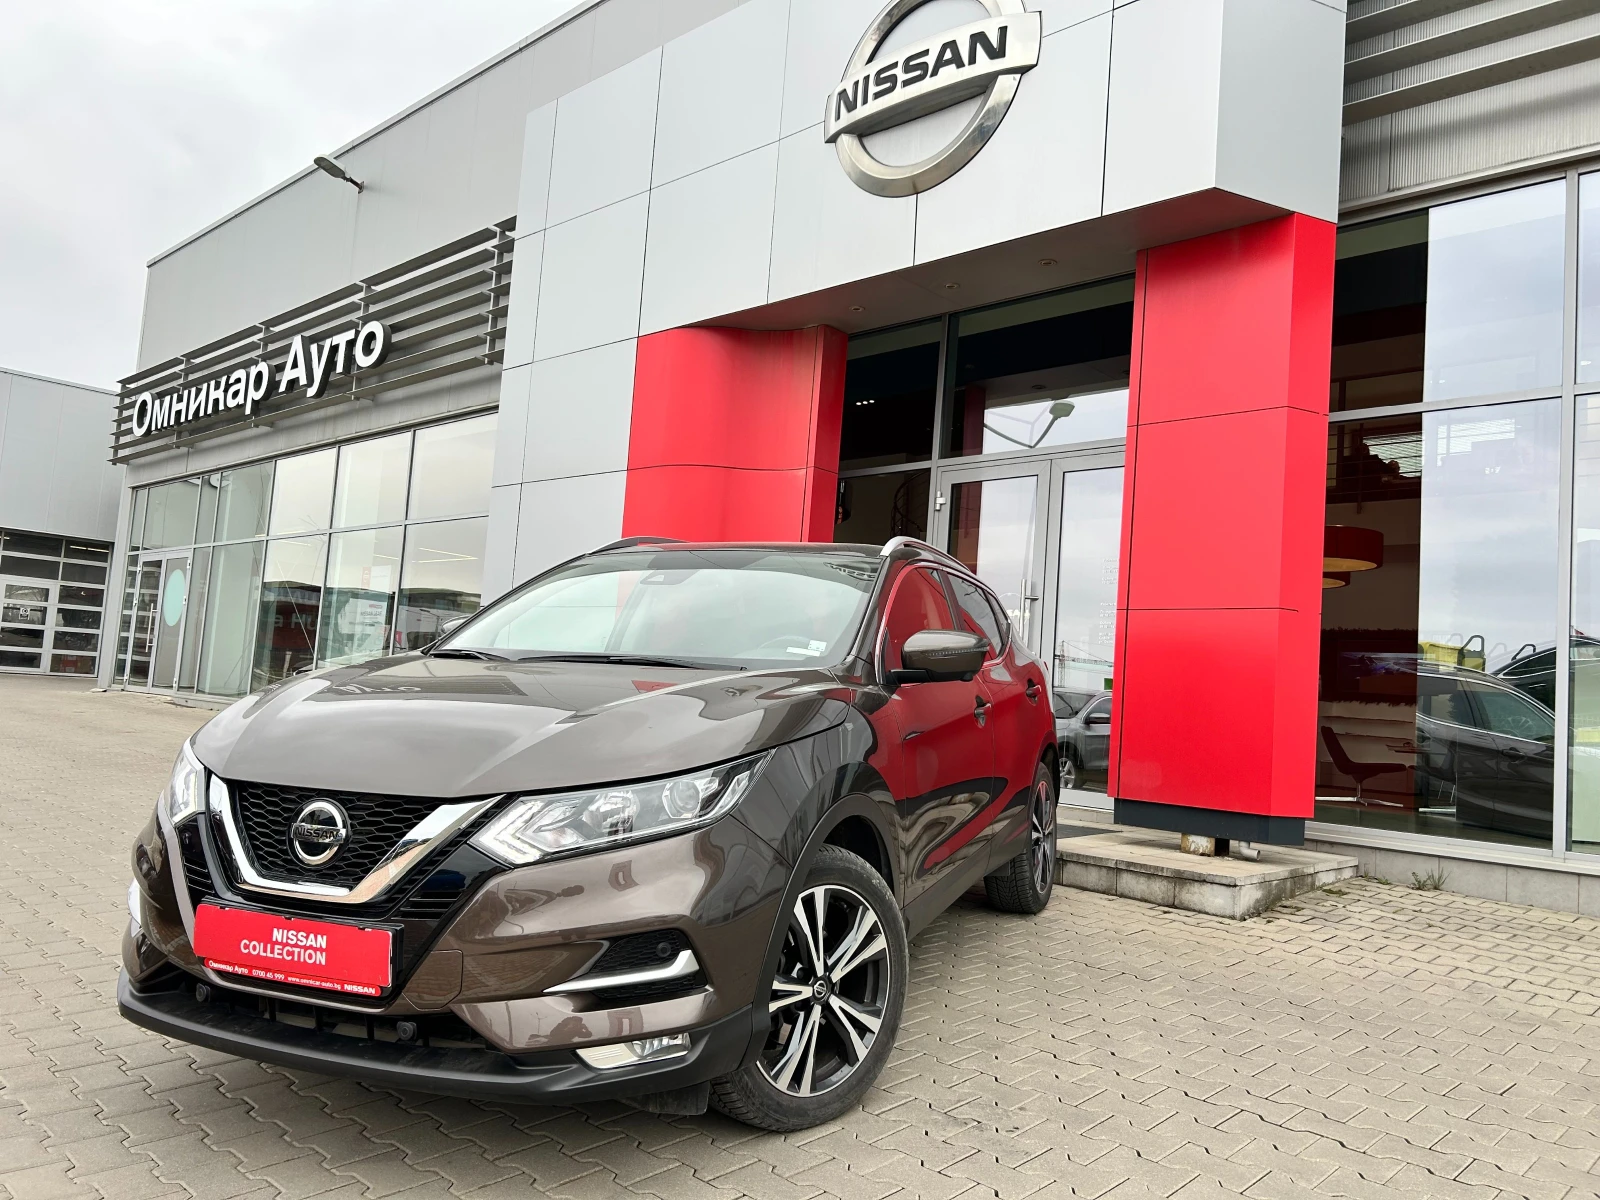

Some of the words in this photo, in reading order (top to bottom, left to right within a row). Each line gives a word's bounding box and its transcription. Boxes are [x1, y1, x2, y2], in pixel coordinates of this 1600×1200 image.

[834, 25, 1008, 122] NISSAN
[132, 361, 274, 437] Омникар
[279, 320, 390, 398] Ауто
[294, 826, 340, 840] NISSAN
[272, 927, 327, 949] NISSAN
[240, 939, 326, 966] COLLECTION
[234, 965, 249, 975] Ауто
[252, 969, 266, 978] 0700
[274, 973, 285, 981] 999
[343, 983, 376, 995] NISSAN
